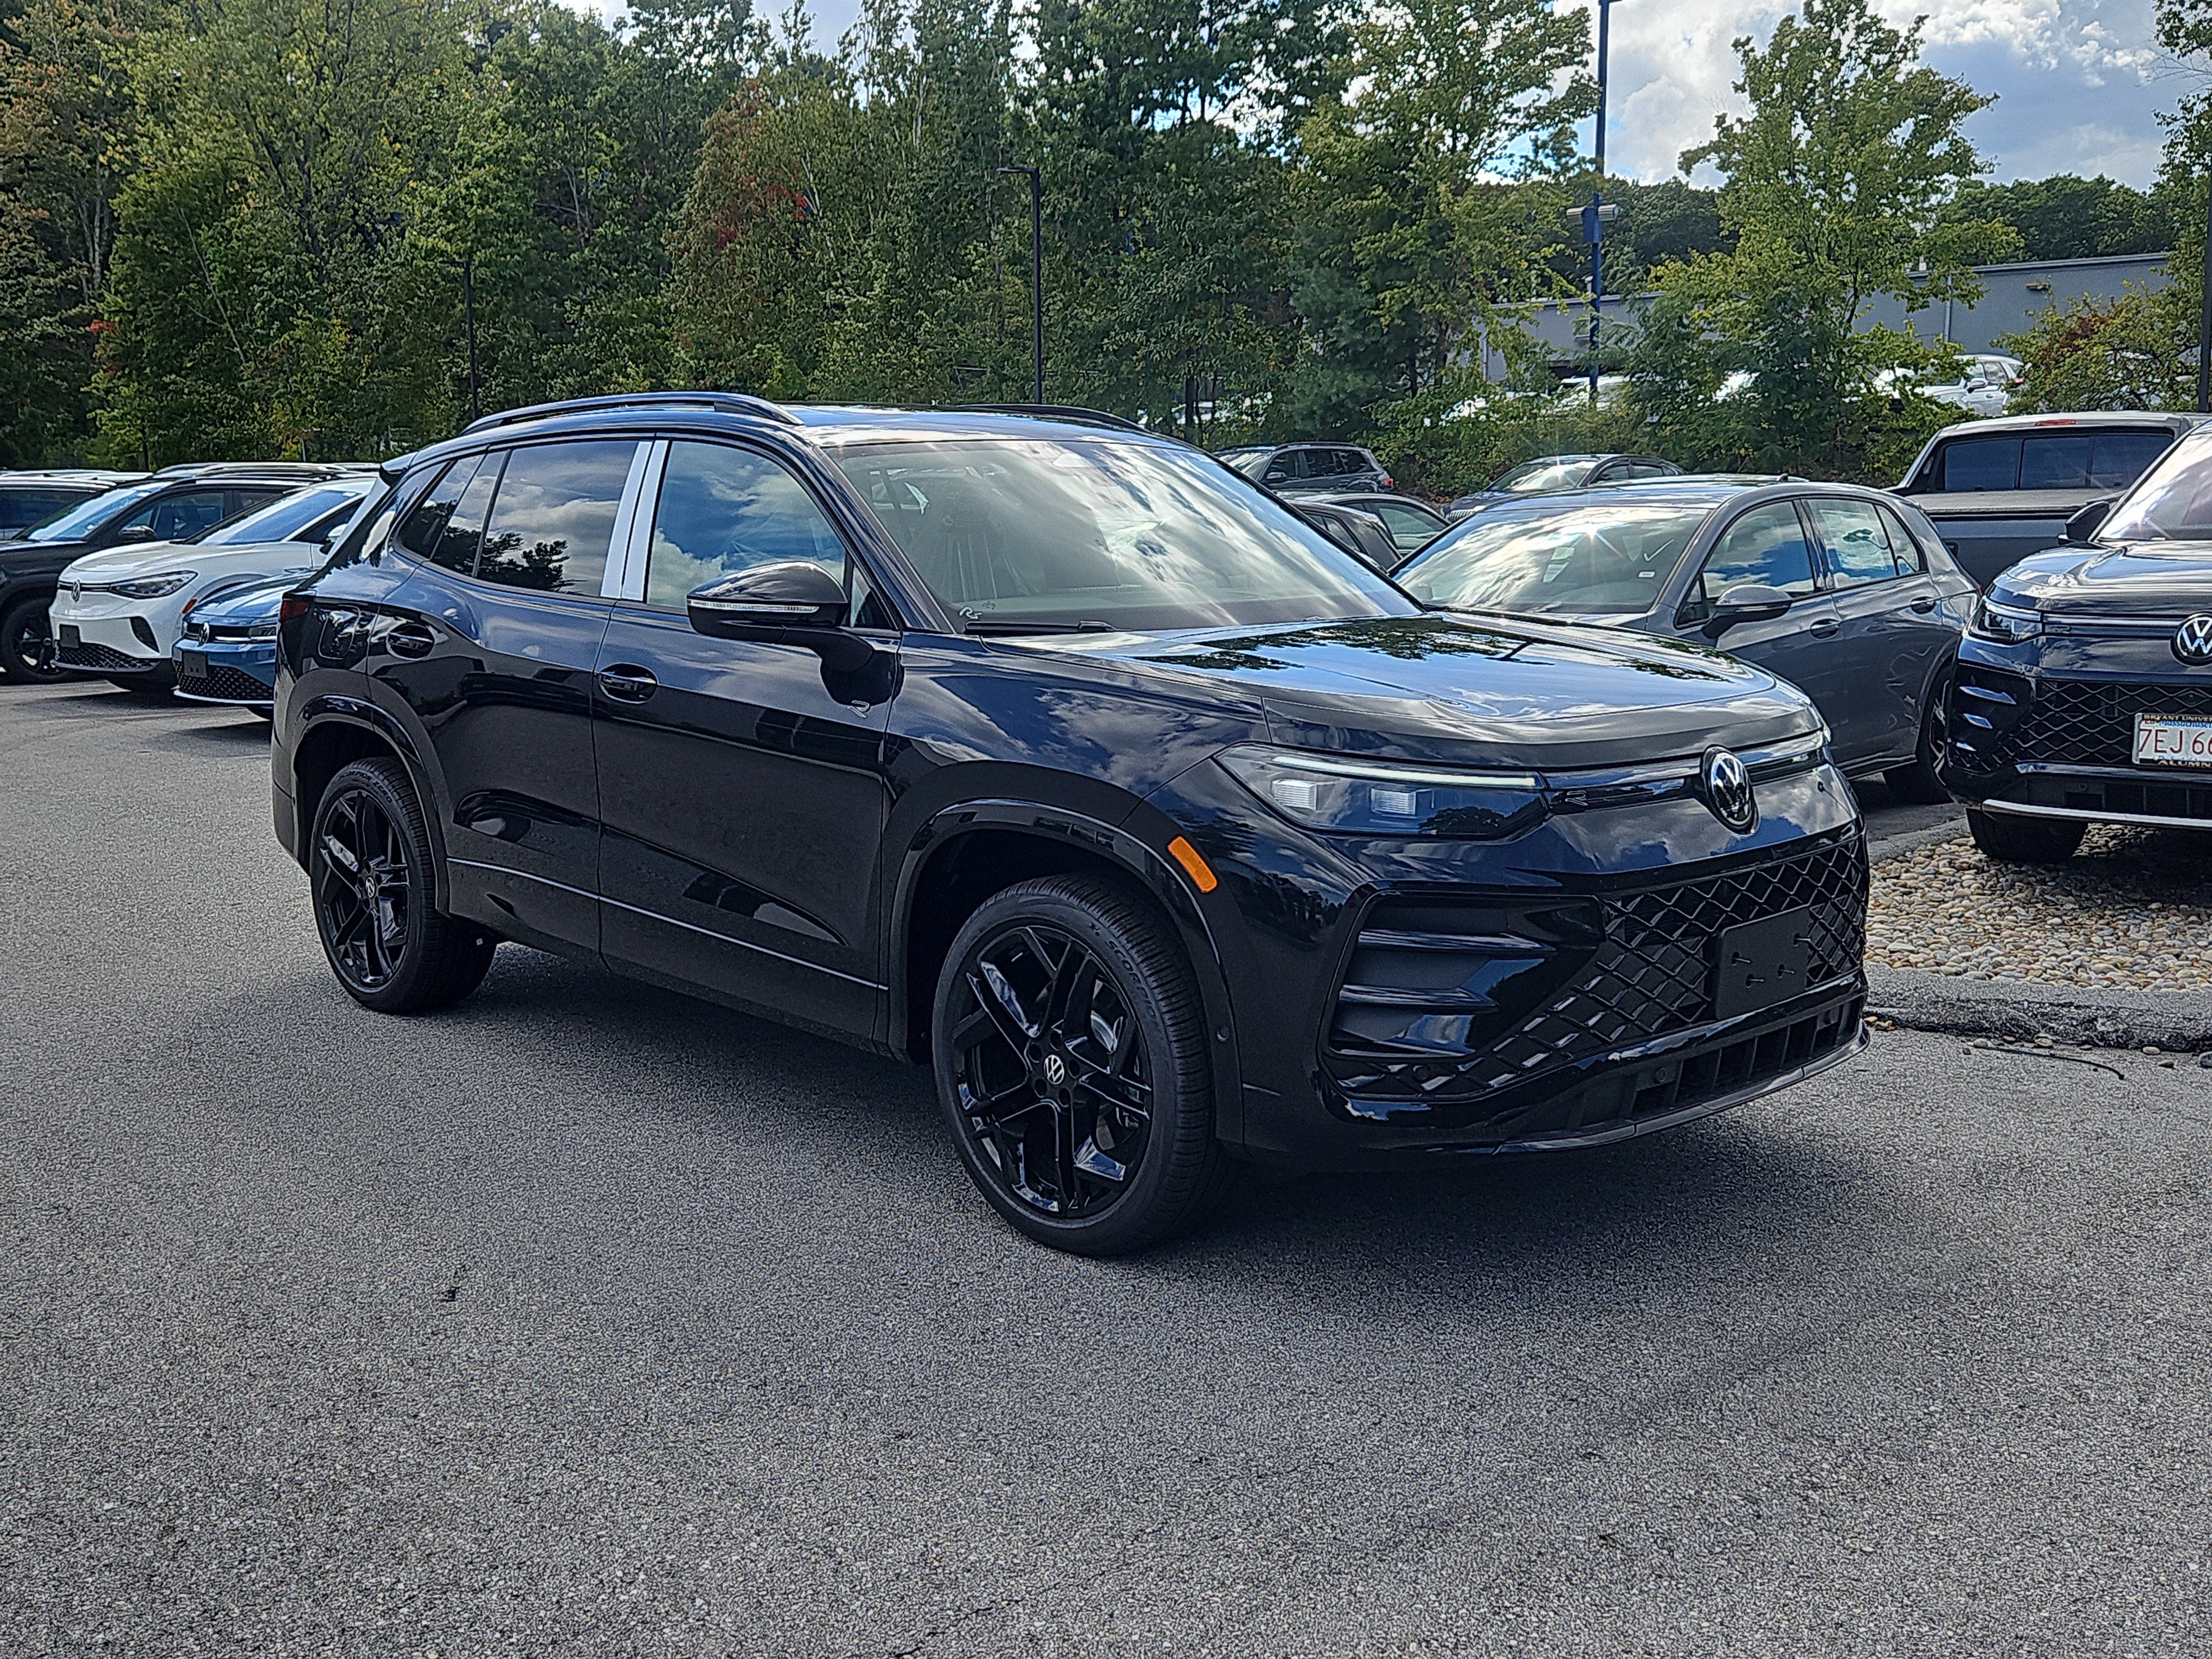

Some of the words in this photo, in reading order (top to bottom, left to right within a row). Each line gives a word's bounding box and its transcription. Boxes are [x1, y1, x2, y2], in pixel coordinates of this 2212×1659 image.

[847, 700, 870, 718] R
[2139, 729, 2183, 754] 7EJ
[1565, 790, 1589, 806] R
[1044, 1054, 1065, 1084] VW
